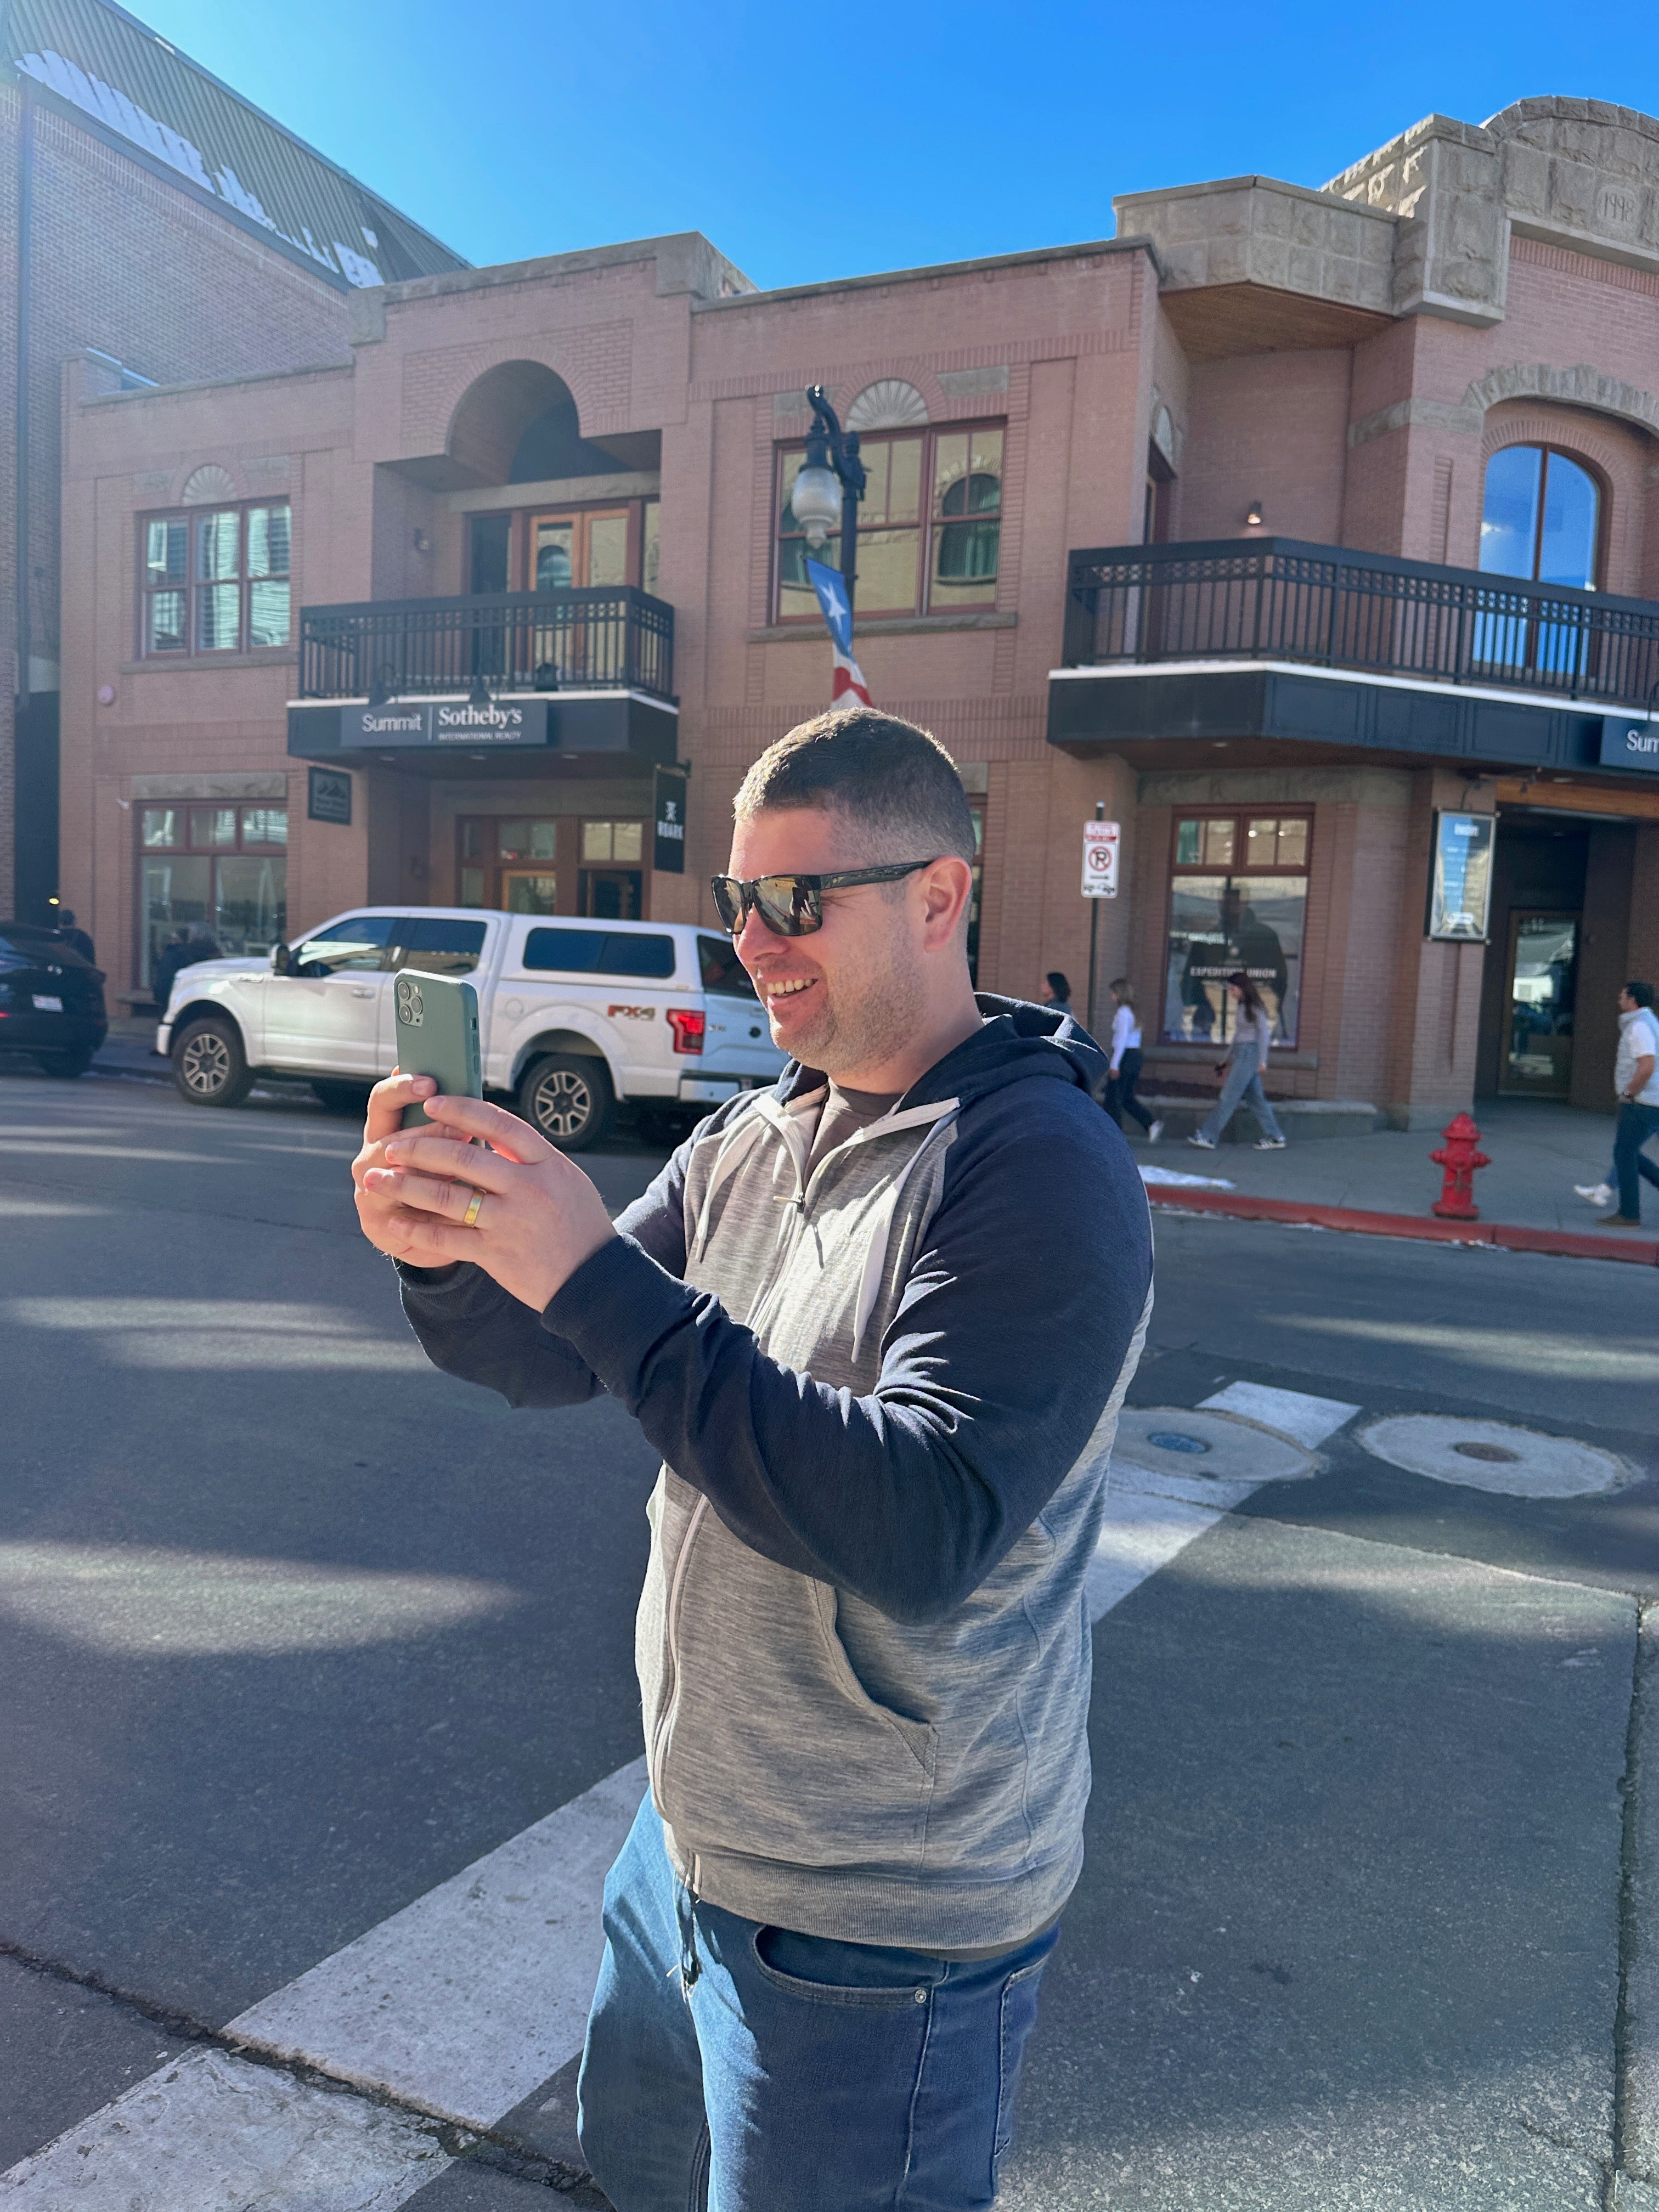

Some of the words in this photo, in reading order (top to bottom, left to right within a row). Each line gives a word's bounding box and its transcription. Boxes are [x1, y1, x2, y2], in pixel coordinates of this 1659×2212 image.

[362, 713, 422, 732] Summit
[438, 704, 522, 729] Sotheby's
[1246, 968, 1277, 979] UNION
[608, 1005, 655, 1020] FX4
